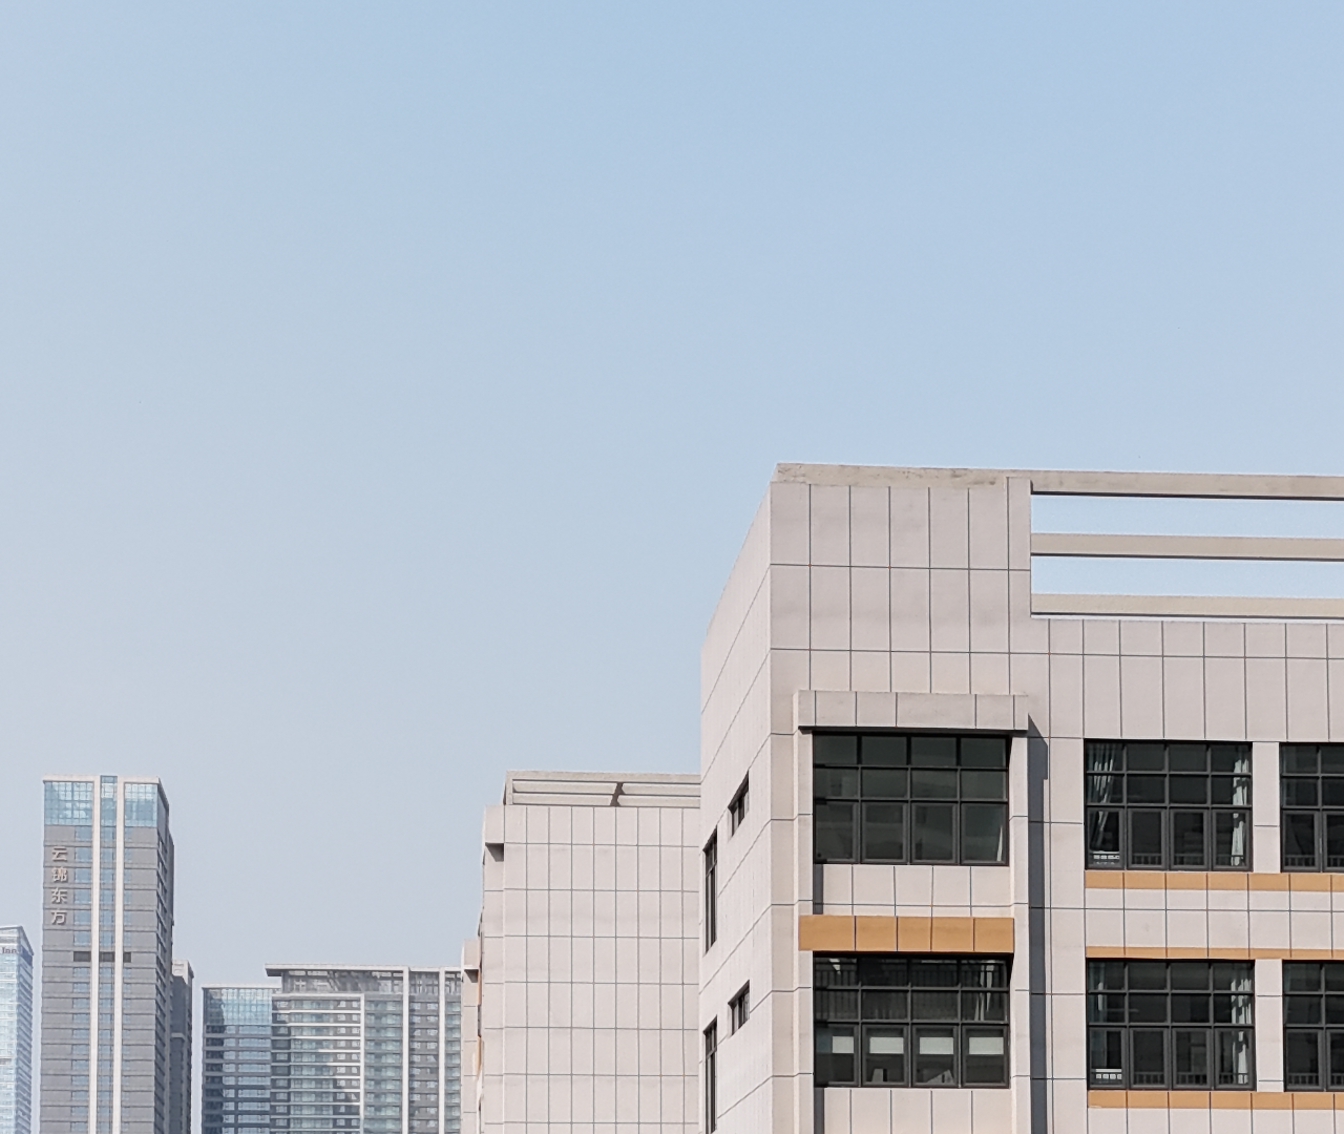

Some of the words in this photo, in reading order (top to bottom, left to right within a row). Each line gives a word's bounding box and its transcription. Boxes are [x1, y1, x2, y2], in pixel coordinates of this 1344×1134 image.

[50, 846, 68, 926] 云锦东方
[2, 946, 17, 954] Inn
